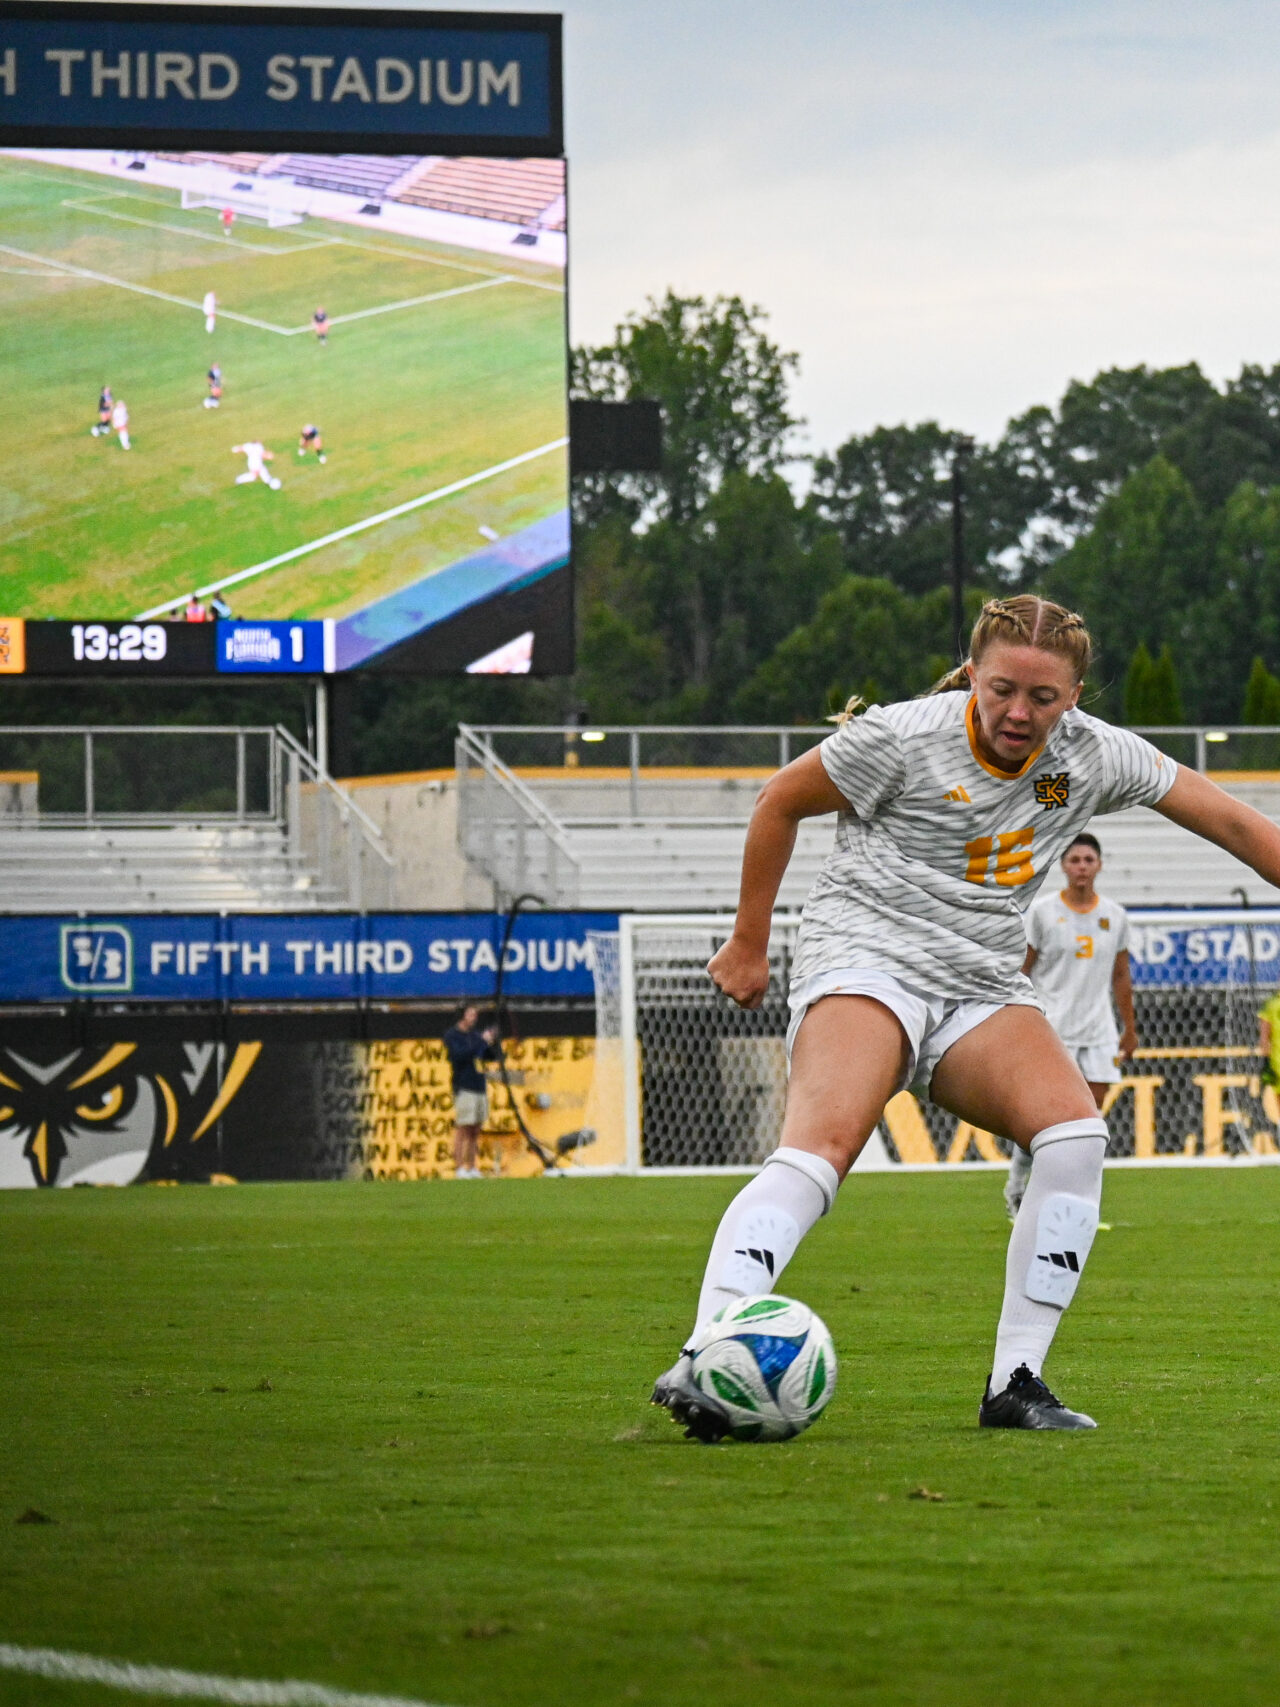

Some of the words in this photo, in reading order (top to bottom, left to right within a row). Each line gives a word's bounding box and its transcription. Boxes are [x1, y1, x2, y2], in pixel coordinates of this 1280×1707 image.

[45, 50, 240, 100] THIRD
[266, 55, 520, 107] STADIUM
[71, 625, 167, 660] 13:29
[290, 626, 304, 662] 1
[151, 942, 269, 975] FIFTH
[286, 940, 413, 974] THIRD
[428, 938, 596, 972] STADIUM
[1075, 936, 1094, 958] 3
[399, 1066, 443, 1087] ALL
